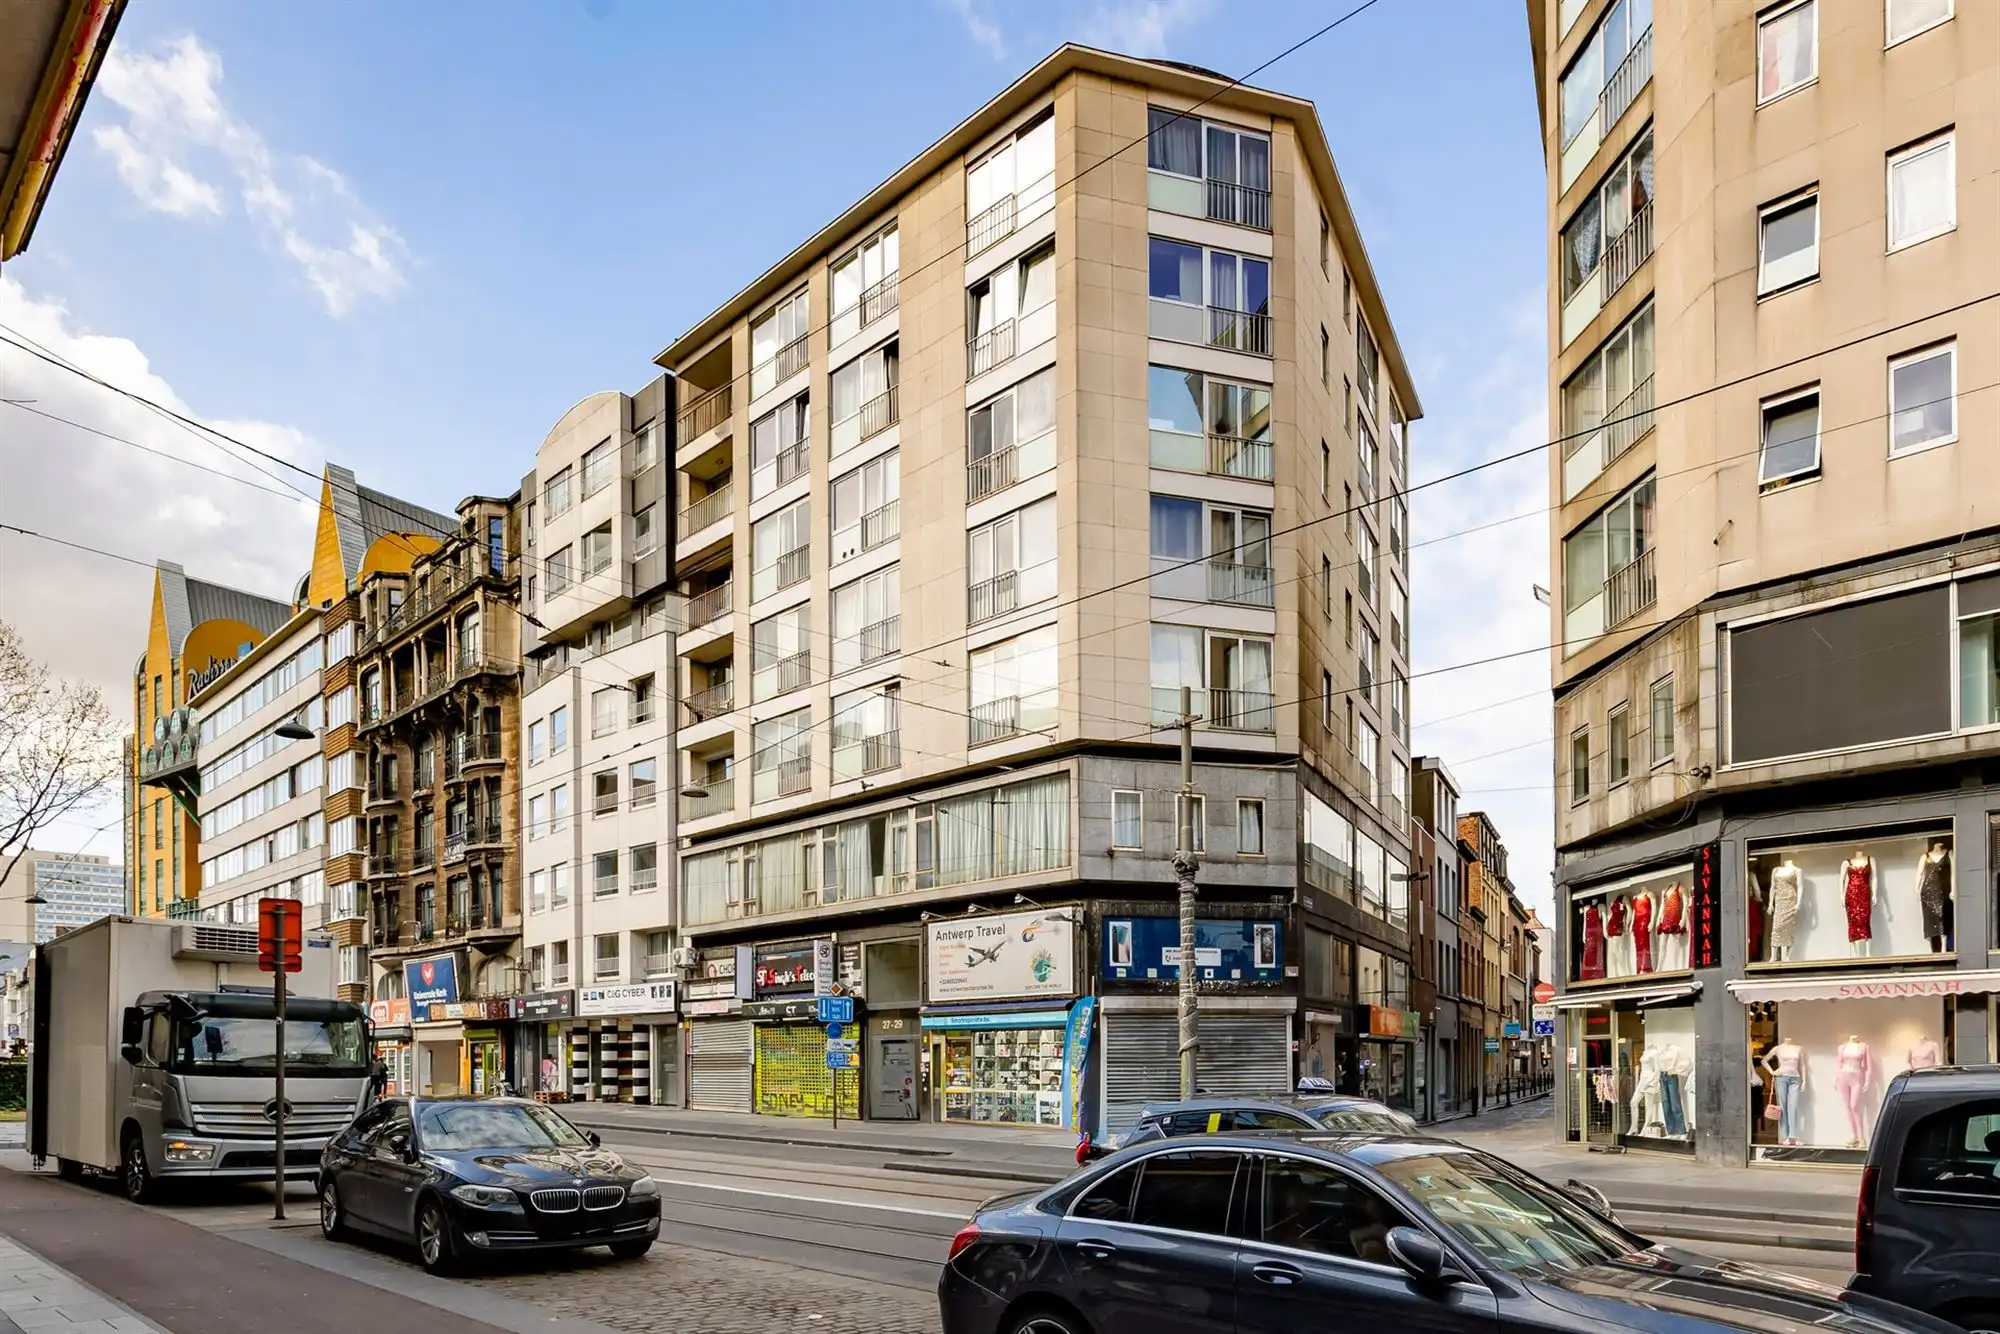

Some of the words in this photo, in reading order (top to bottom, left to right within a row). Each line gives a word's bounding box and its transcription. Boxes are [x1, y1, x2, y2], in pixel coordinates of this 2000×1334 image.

[1702, 847, 1711, 966] SAVANNAH
[936, 930, 974, 942] Antwerp
[975, 923, 1006, 938] Travel
[767, 968, 796, 986] Singh's
[622, 987, 646, 998] CYBER
[1839, 981, 1962, 996] SAVANNAH
